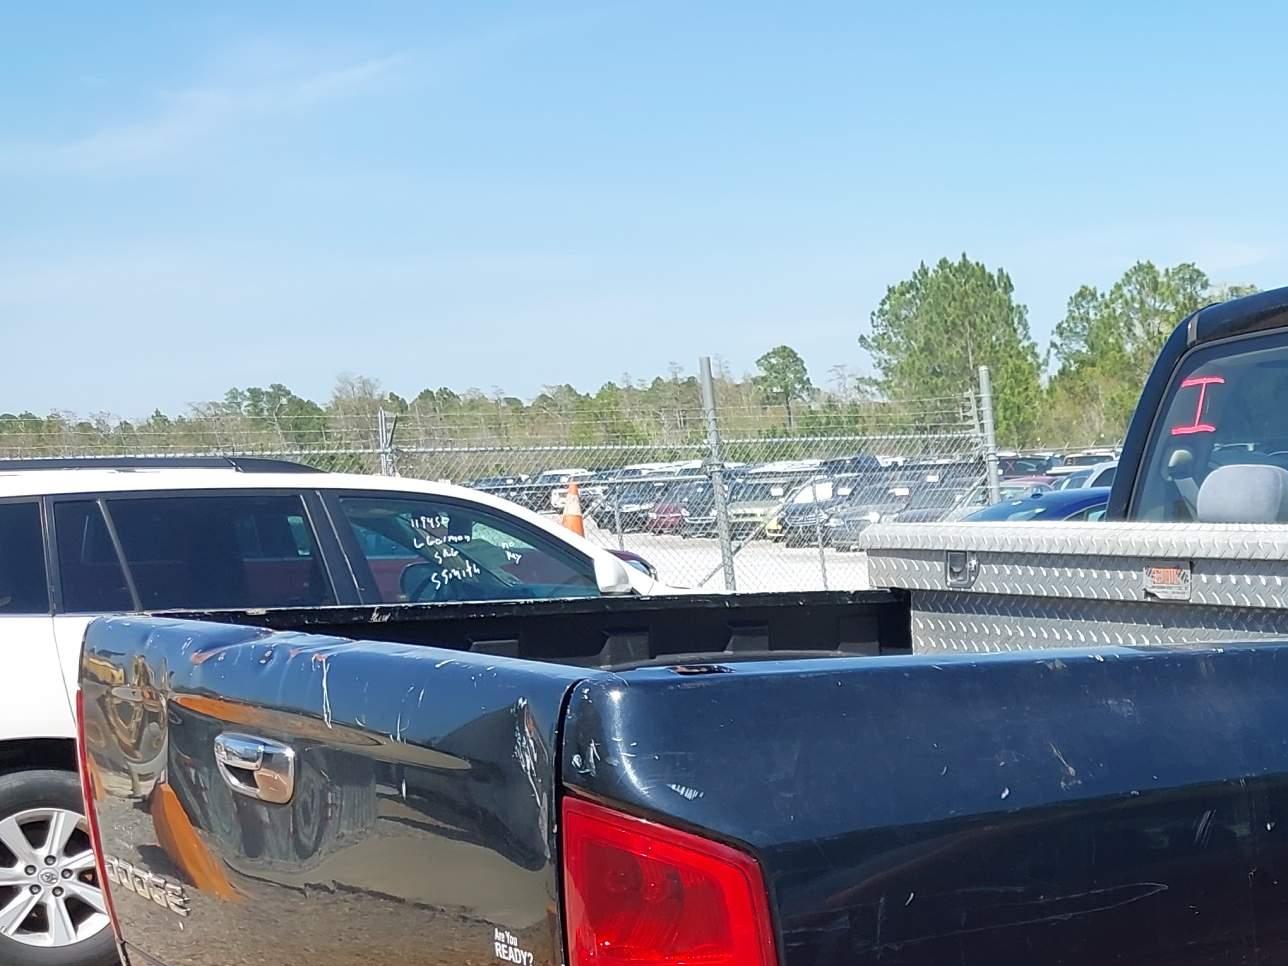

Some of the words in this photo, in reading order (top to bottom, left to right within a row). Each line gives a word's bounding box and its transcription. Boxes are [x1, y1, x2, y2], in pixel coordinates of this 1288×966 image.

[104, 855, 192, 917] DODGE
[494, 927, 505, 943] Are
[505, 930, 518, 947] You
